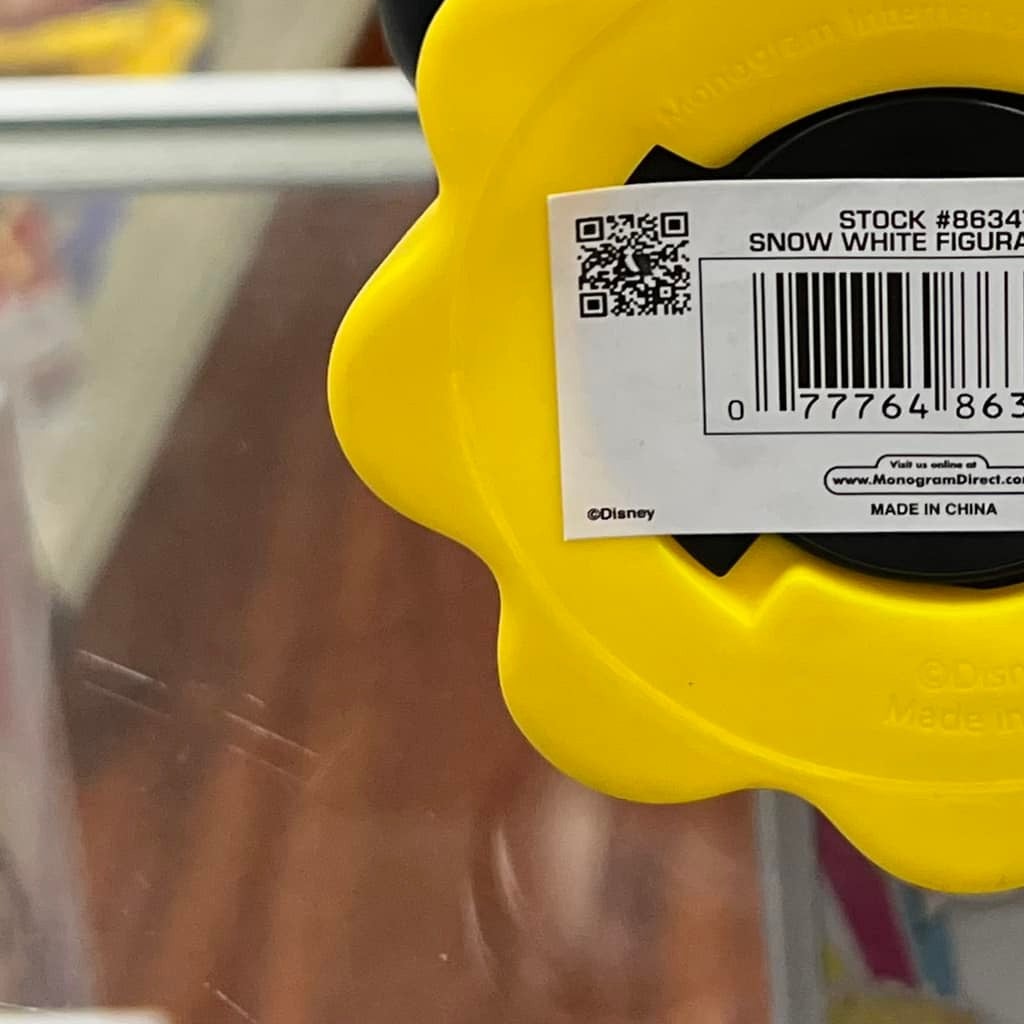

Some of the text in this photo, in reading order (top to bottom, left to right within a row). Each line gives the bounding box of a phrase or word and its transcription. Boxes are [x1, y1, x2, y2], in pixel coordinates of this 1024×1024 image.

[839, 209, 926, 230] STOCK
[749, 232, 834, 253] SNOW
[841, 232, 928, 252] WHITE
[799, 393, 930, 420] 77764
[890, 460, 978, 470] Visit us online at
[870, 503, 999, 516] MADE IN CHINA
[884, 692, 985, 733] Made
